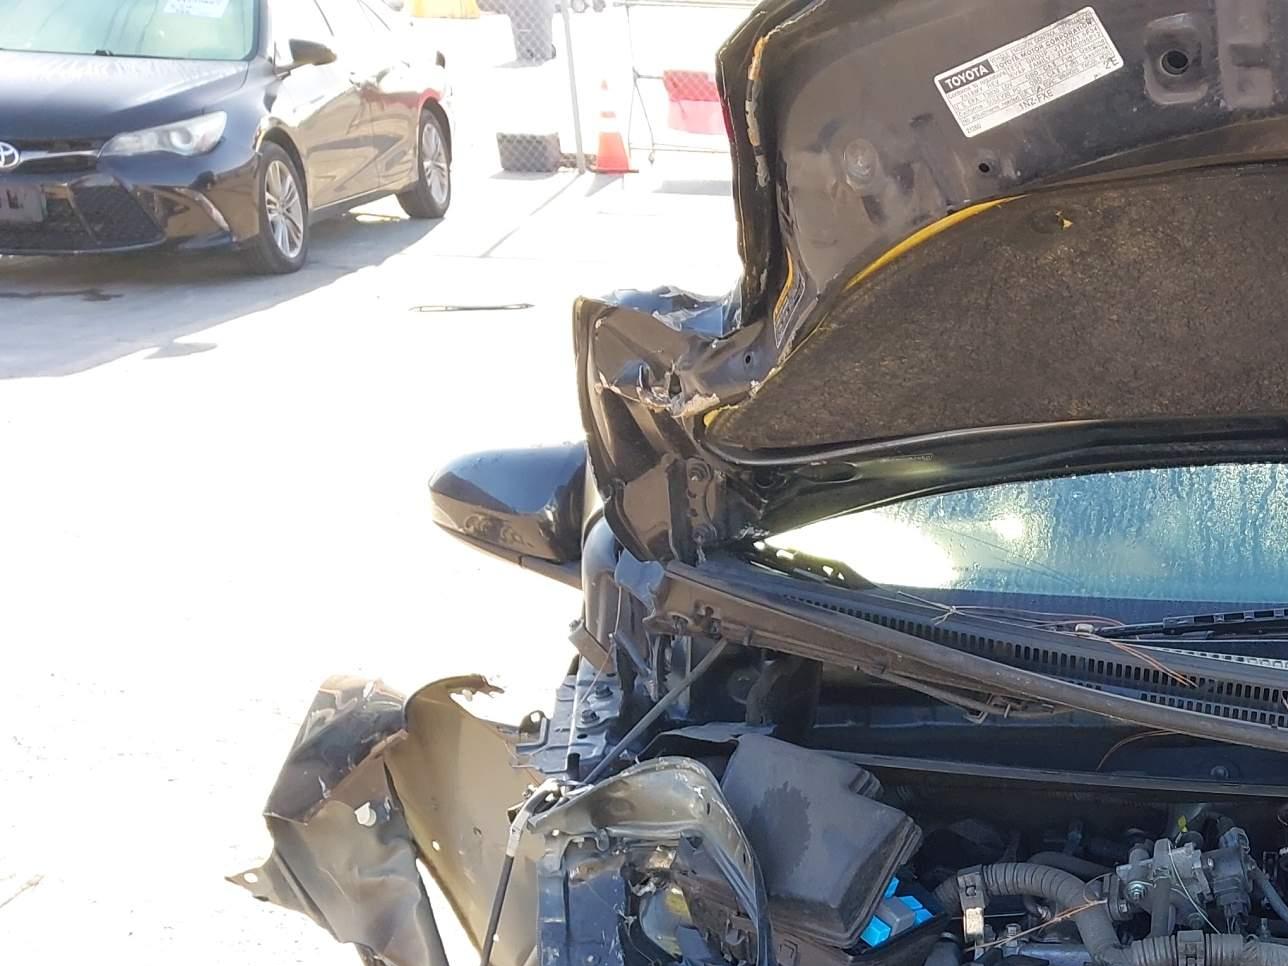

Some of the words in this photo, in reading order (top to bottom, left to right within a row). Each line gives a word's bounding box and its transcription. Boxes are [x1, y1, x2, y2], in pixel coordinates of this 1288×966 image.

[994, 54, 1020, 70] TOYOTA
[1019, 43, 1044, 58] MOTOR
[1043, 19, 1094, 47] CORPORATION
[944, 62, 989, 90] TOYOTA
